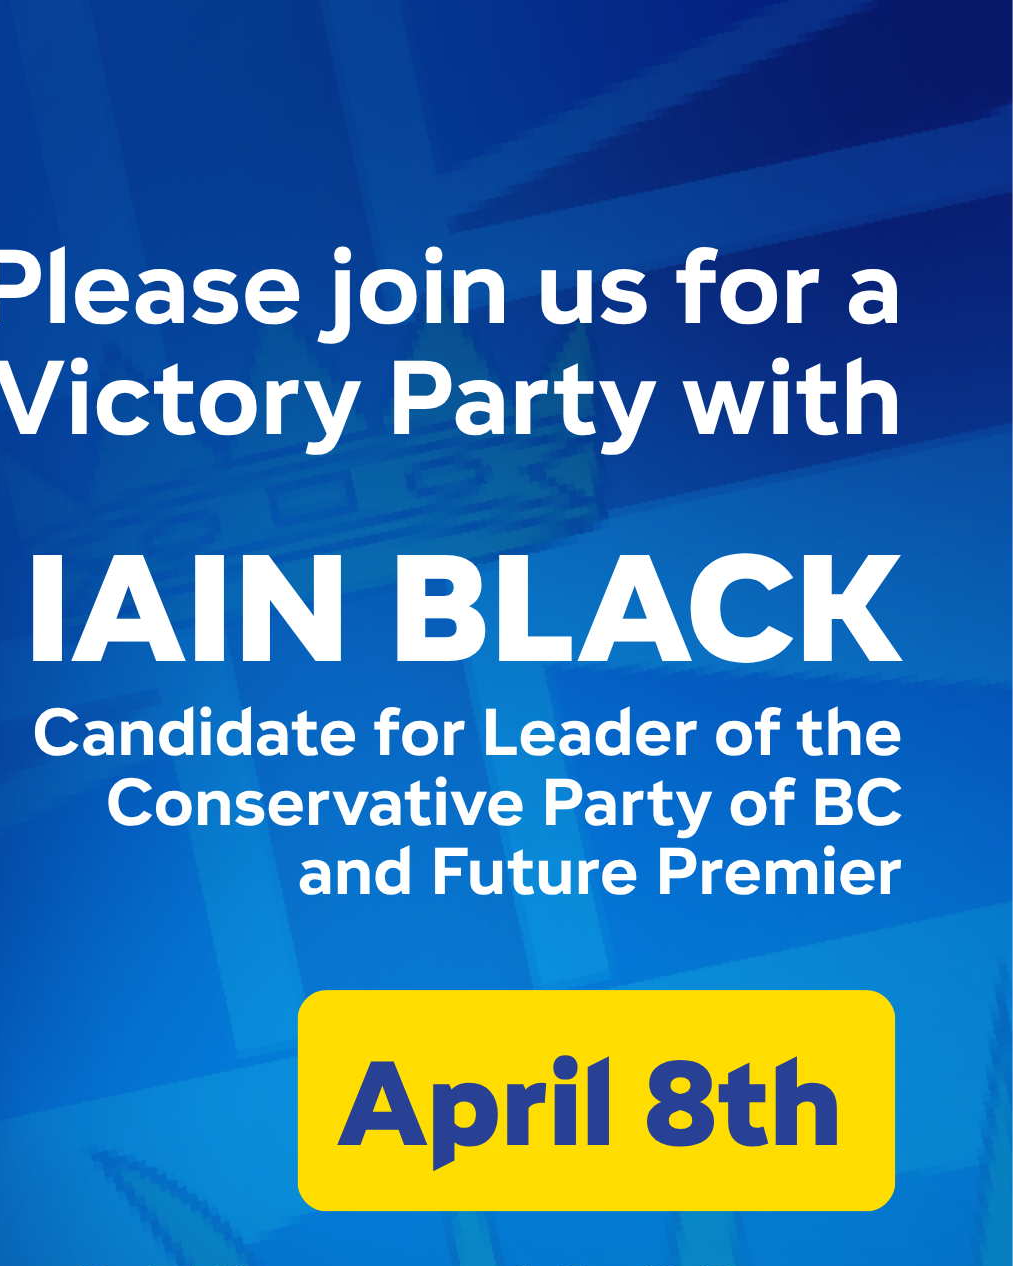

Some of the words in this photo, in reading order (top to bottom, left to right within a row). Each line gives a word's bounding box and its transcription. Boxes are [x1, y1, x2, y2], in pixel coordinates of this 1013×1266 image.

[318, 247, 504, 344] join
[542, 269, 647, 324] us
[677, 247, 819, 324] for
[849, 269, 897, 324] a
[394, 361, 656, 455] Party
[683, 357, 897, 435] with
[33, 555, 341, 661] IAIN
[397, 553, 902, 663] BLACK
[35, 707, 355, 756] Candidate
[374, 707, 465, 756] for
[486, 707, 697, 756] Leader
[716, 707, 781, 756] of
[797, 707, 900, 756] the
[108, 777, 522, 826] Conservative
[546, 779, 712, 839] Party
[731, 777, 796, 826] of
[816, 778, 901, 826] BC
[300, 846, 409, 895] and
[435, 848, 636, 895] Future
[660, 846, 901, 895] Premier
[337, 1055, 609, 1171] April
[647, 1057, 837, 1146] 8th
